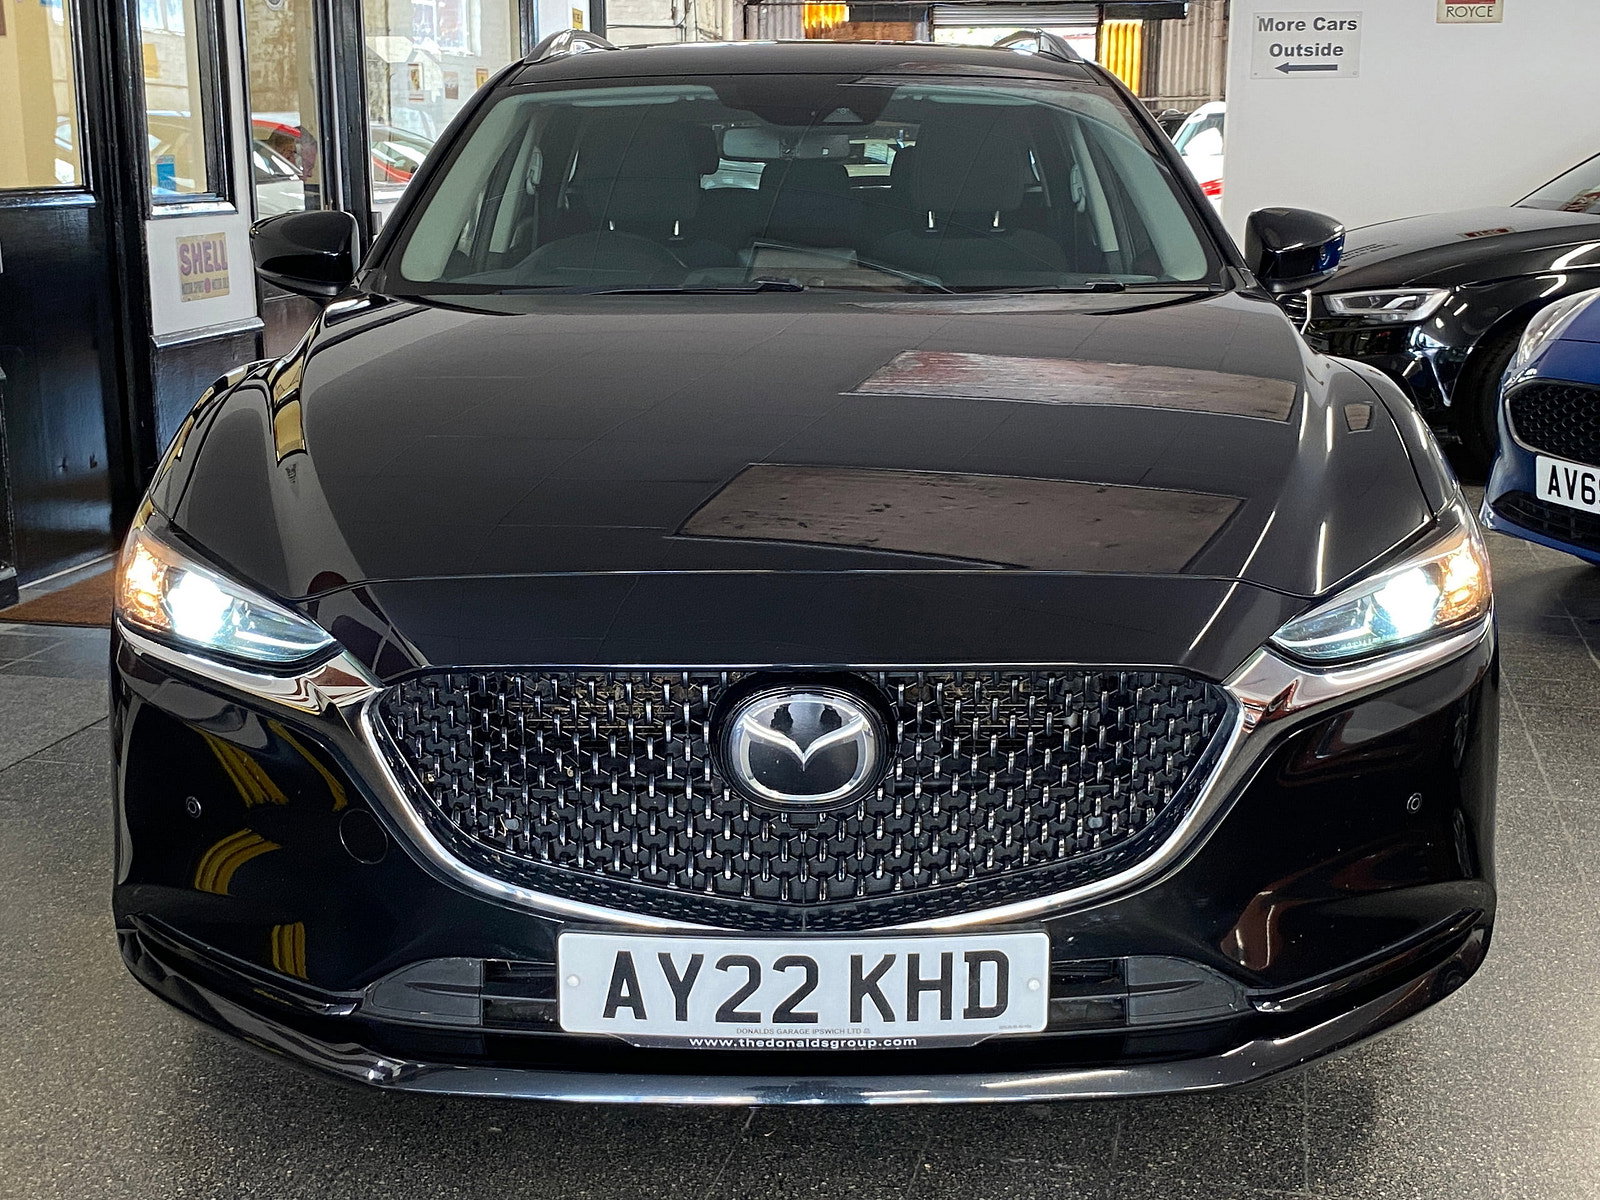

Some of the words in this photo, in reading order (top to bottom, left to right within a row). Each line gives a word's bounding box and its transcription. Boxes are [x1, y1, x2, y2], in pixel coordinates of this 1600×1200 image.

[1446, 6, 1494, 17] ROYCE
[1258, 17, 1306, 31] More
[1313, 16, 1358, 31] Cars
[1269, 43, 1344, 57] Outside
[179, 240, 229, 276] SHELL
[1547, 464, 1600, 506] AV6
[602, 950, 819, 1024] AY22
[849, 949, 1010, 1024] KHD
[689, 1037, 918, 1049] www.thedonaldsgroup.com
